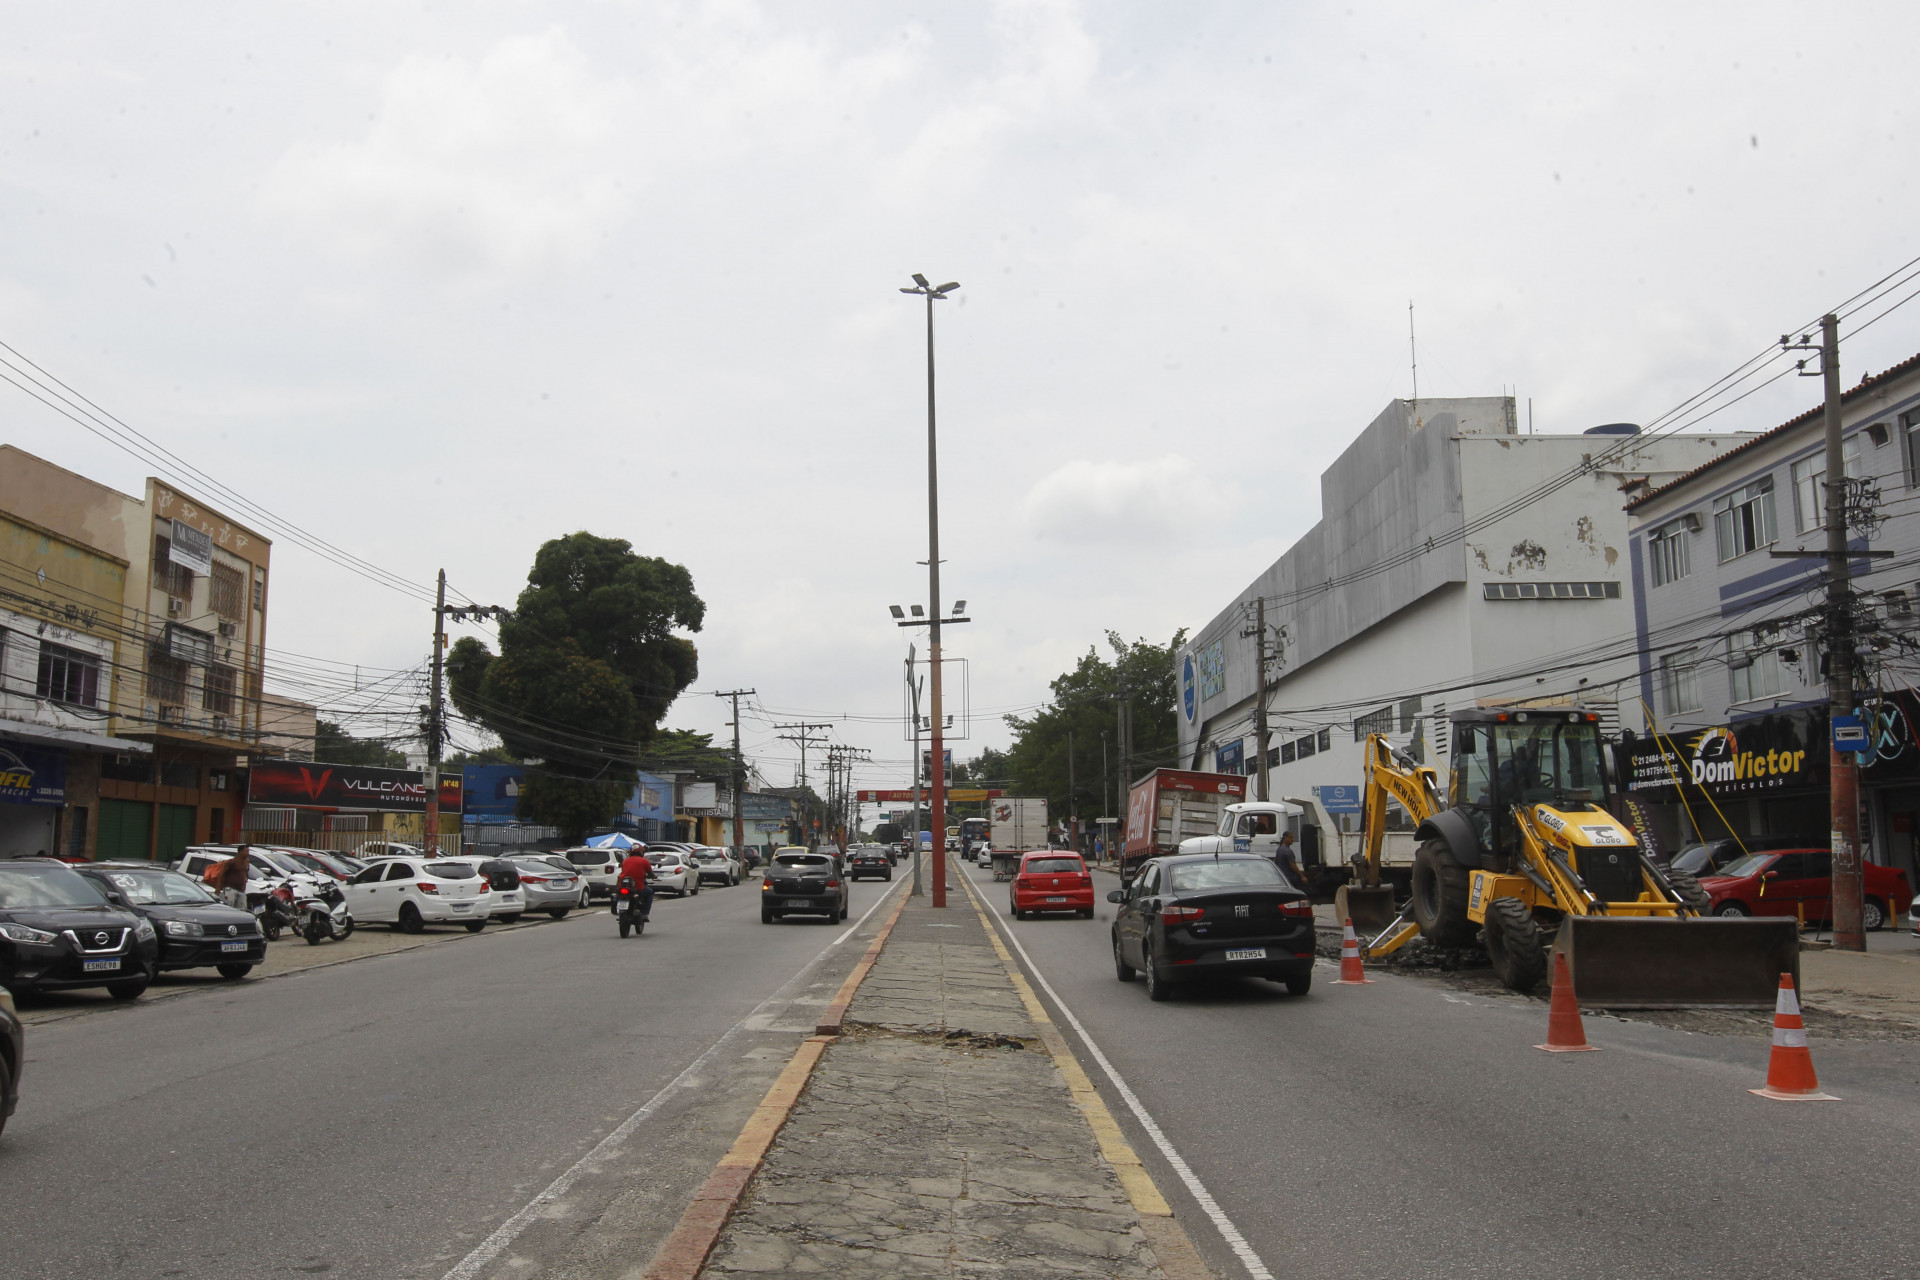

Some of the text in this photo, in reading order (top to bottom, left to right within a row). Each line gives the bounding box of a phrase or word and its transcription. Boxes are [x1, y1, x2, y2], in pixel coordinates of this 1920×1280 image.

[1645, 752, 1676, 763] 2484-654
[1393, 779, 1408, 799] NEW
[1543, 814, 1565, 831] GLOBO
[1234, 904, 1250, 918] FIAT
